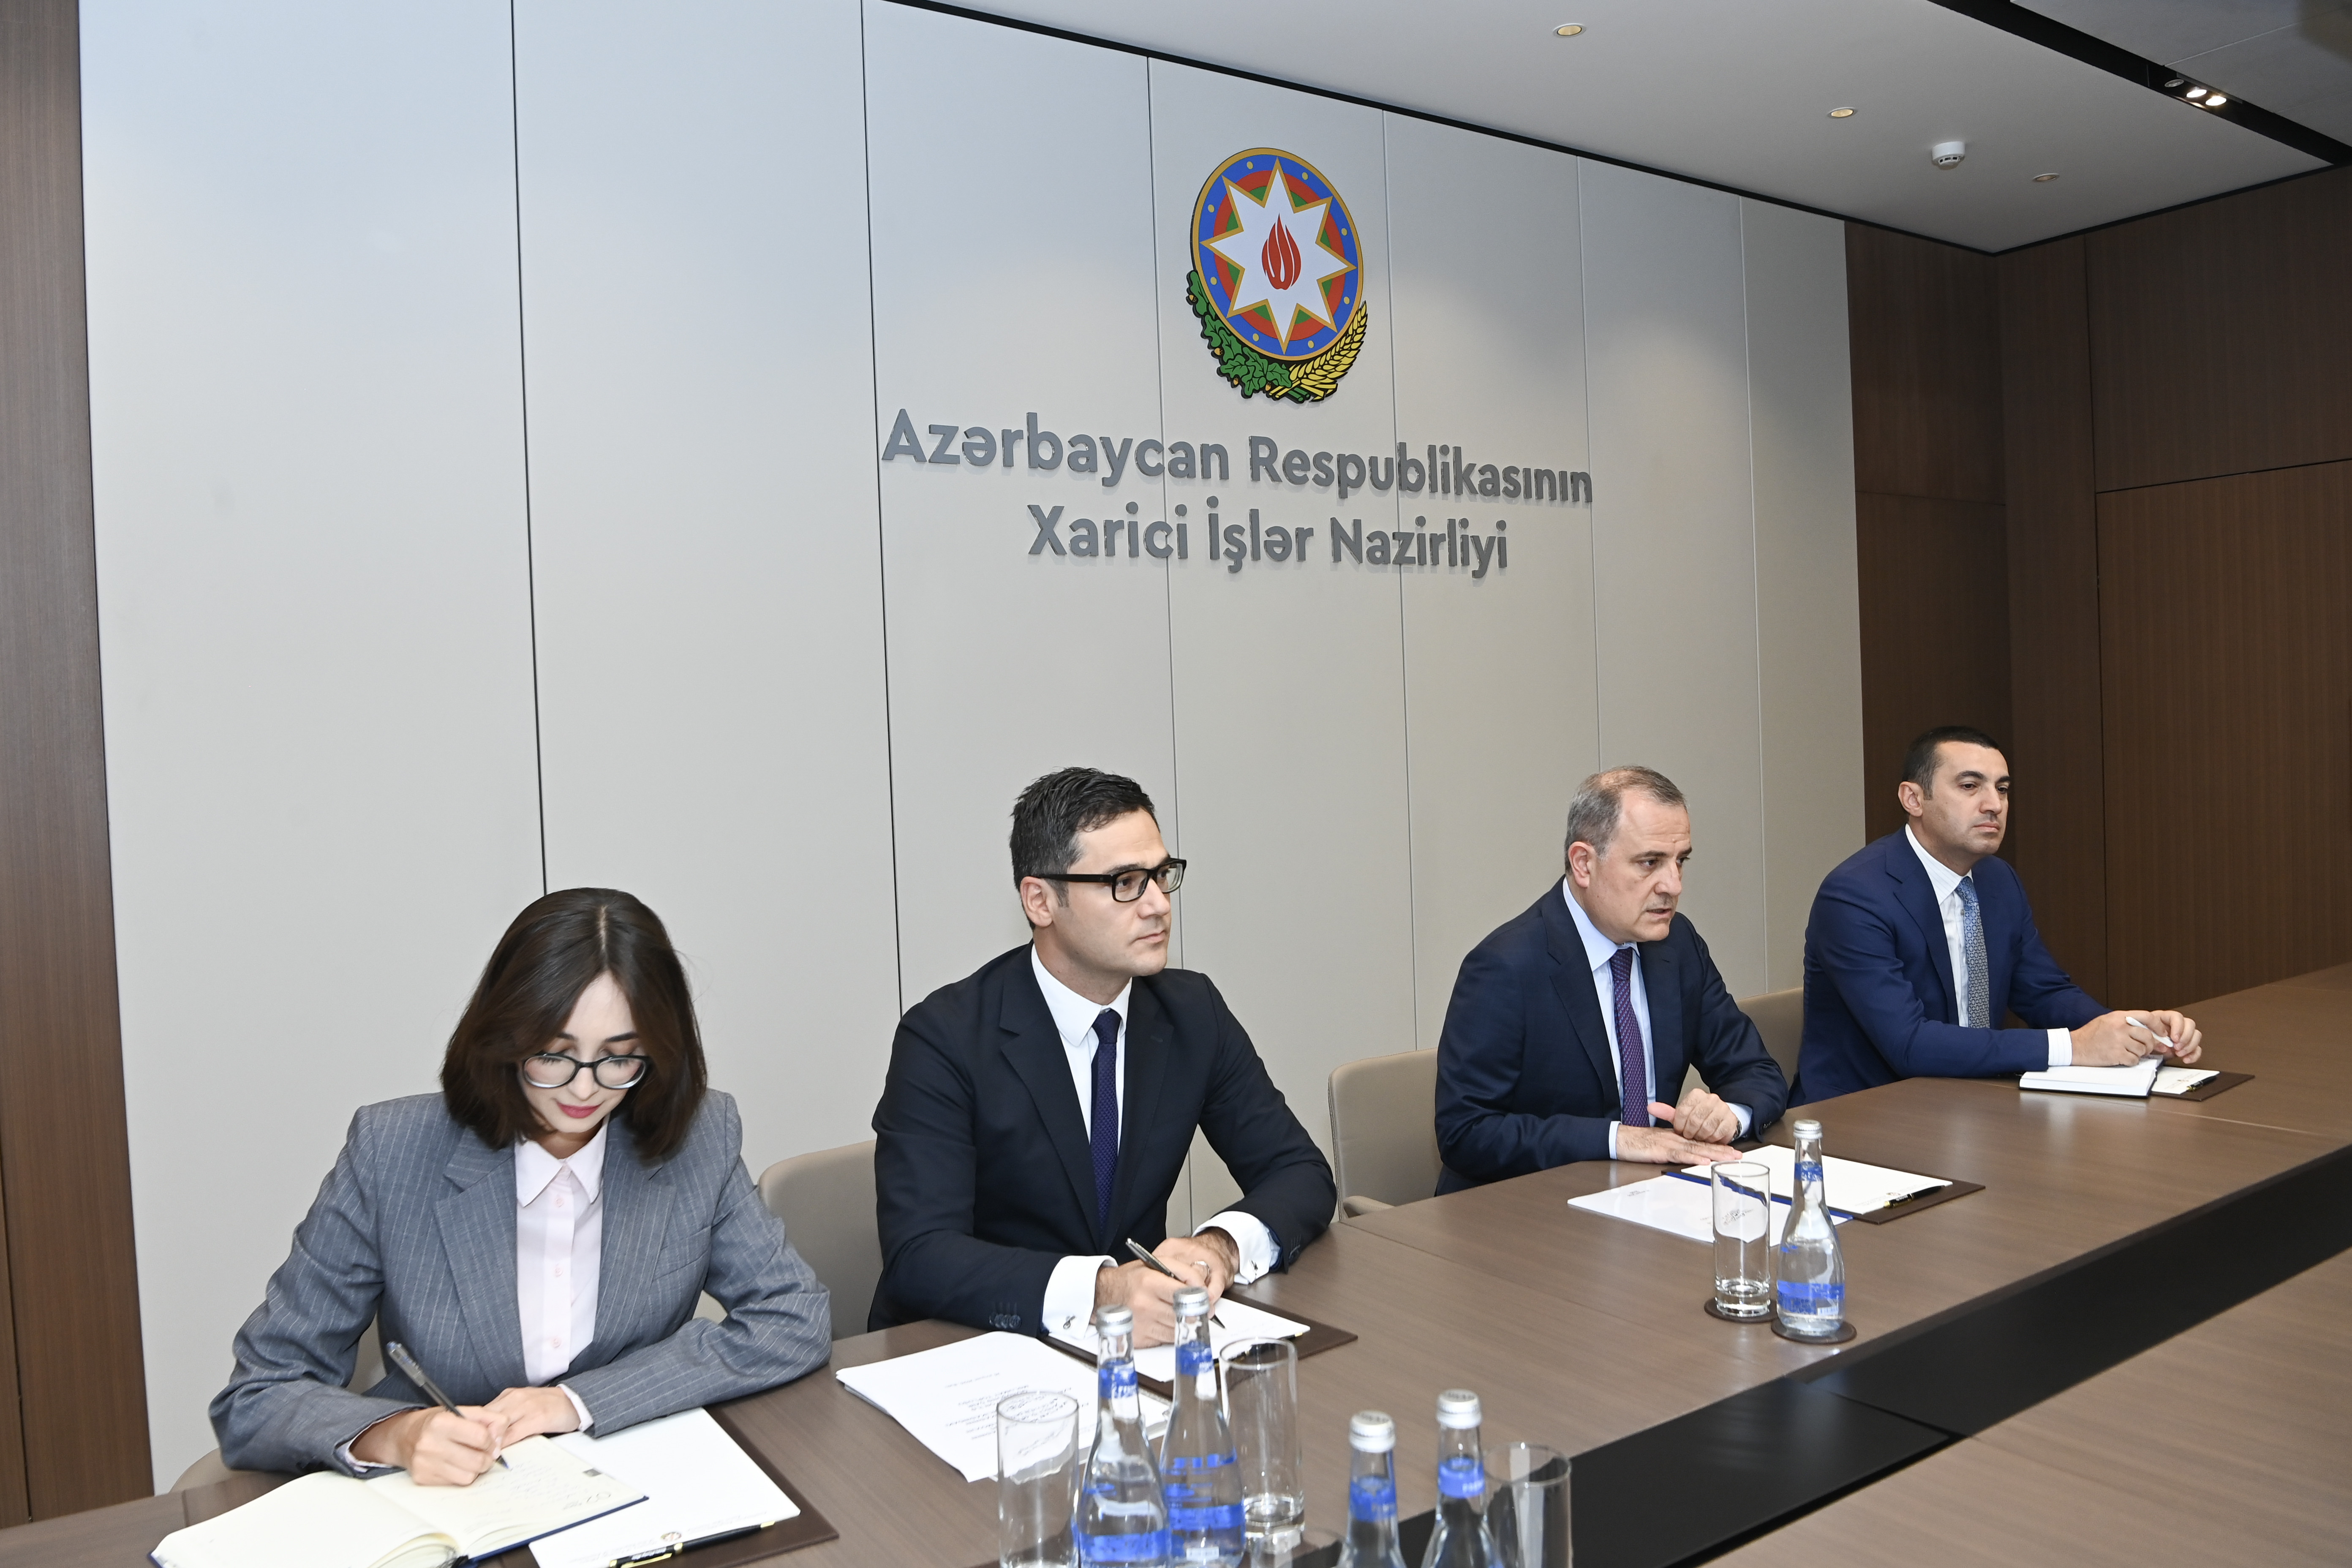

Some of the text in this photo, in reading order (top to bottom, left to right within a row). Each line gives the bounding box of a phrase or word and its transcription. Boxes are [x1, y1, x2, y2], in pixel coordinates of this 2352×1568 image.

[882, 408, 1592, 502] Azərbaycan Respublikasının
[1027, 495, 1508, 578] Xarici İşlər Nazirliyi
